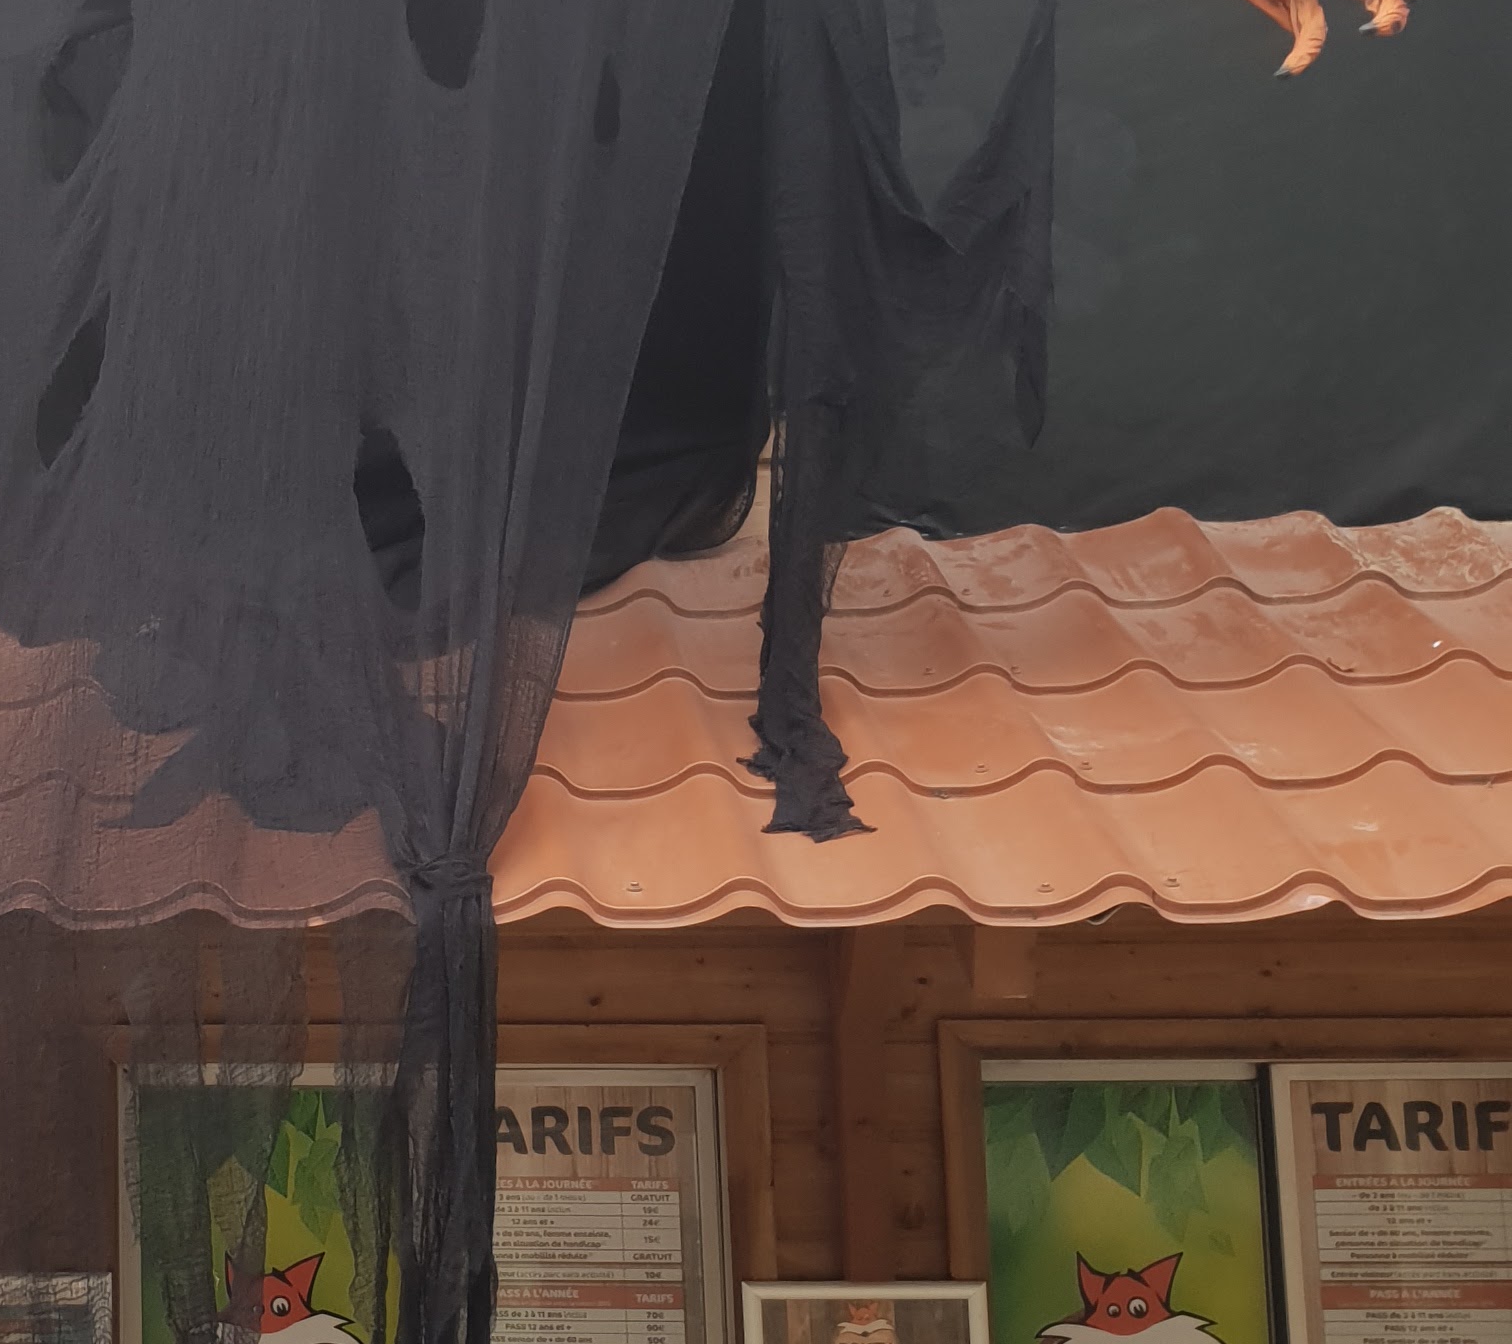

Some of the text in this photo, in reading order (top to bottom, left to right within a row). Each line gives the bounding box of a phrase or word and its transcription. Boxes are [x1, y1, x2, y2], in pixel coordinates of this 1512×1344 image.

[495, 1106, 675, 1156] ARIFS
[1311, 1100, 1511, 1152] TARIF
[516, 1179, 591, 1189] À LA JOURNÉE
[631, 1181, 668, 1189] TARIFS
[499, 1290, 520, 1298] ASS
[534, 1287, 579, 1298] L'ANNÉE
[636, 1294, 673, 1303] TARIFS
